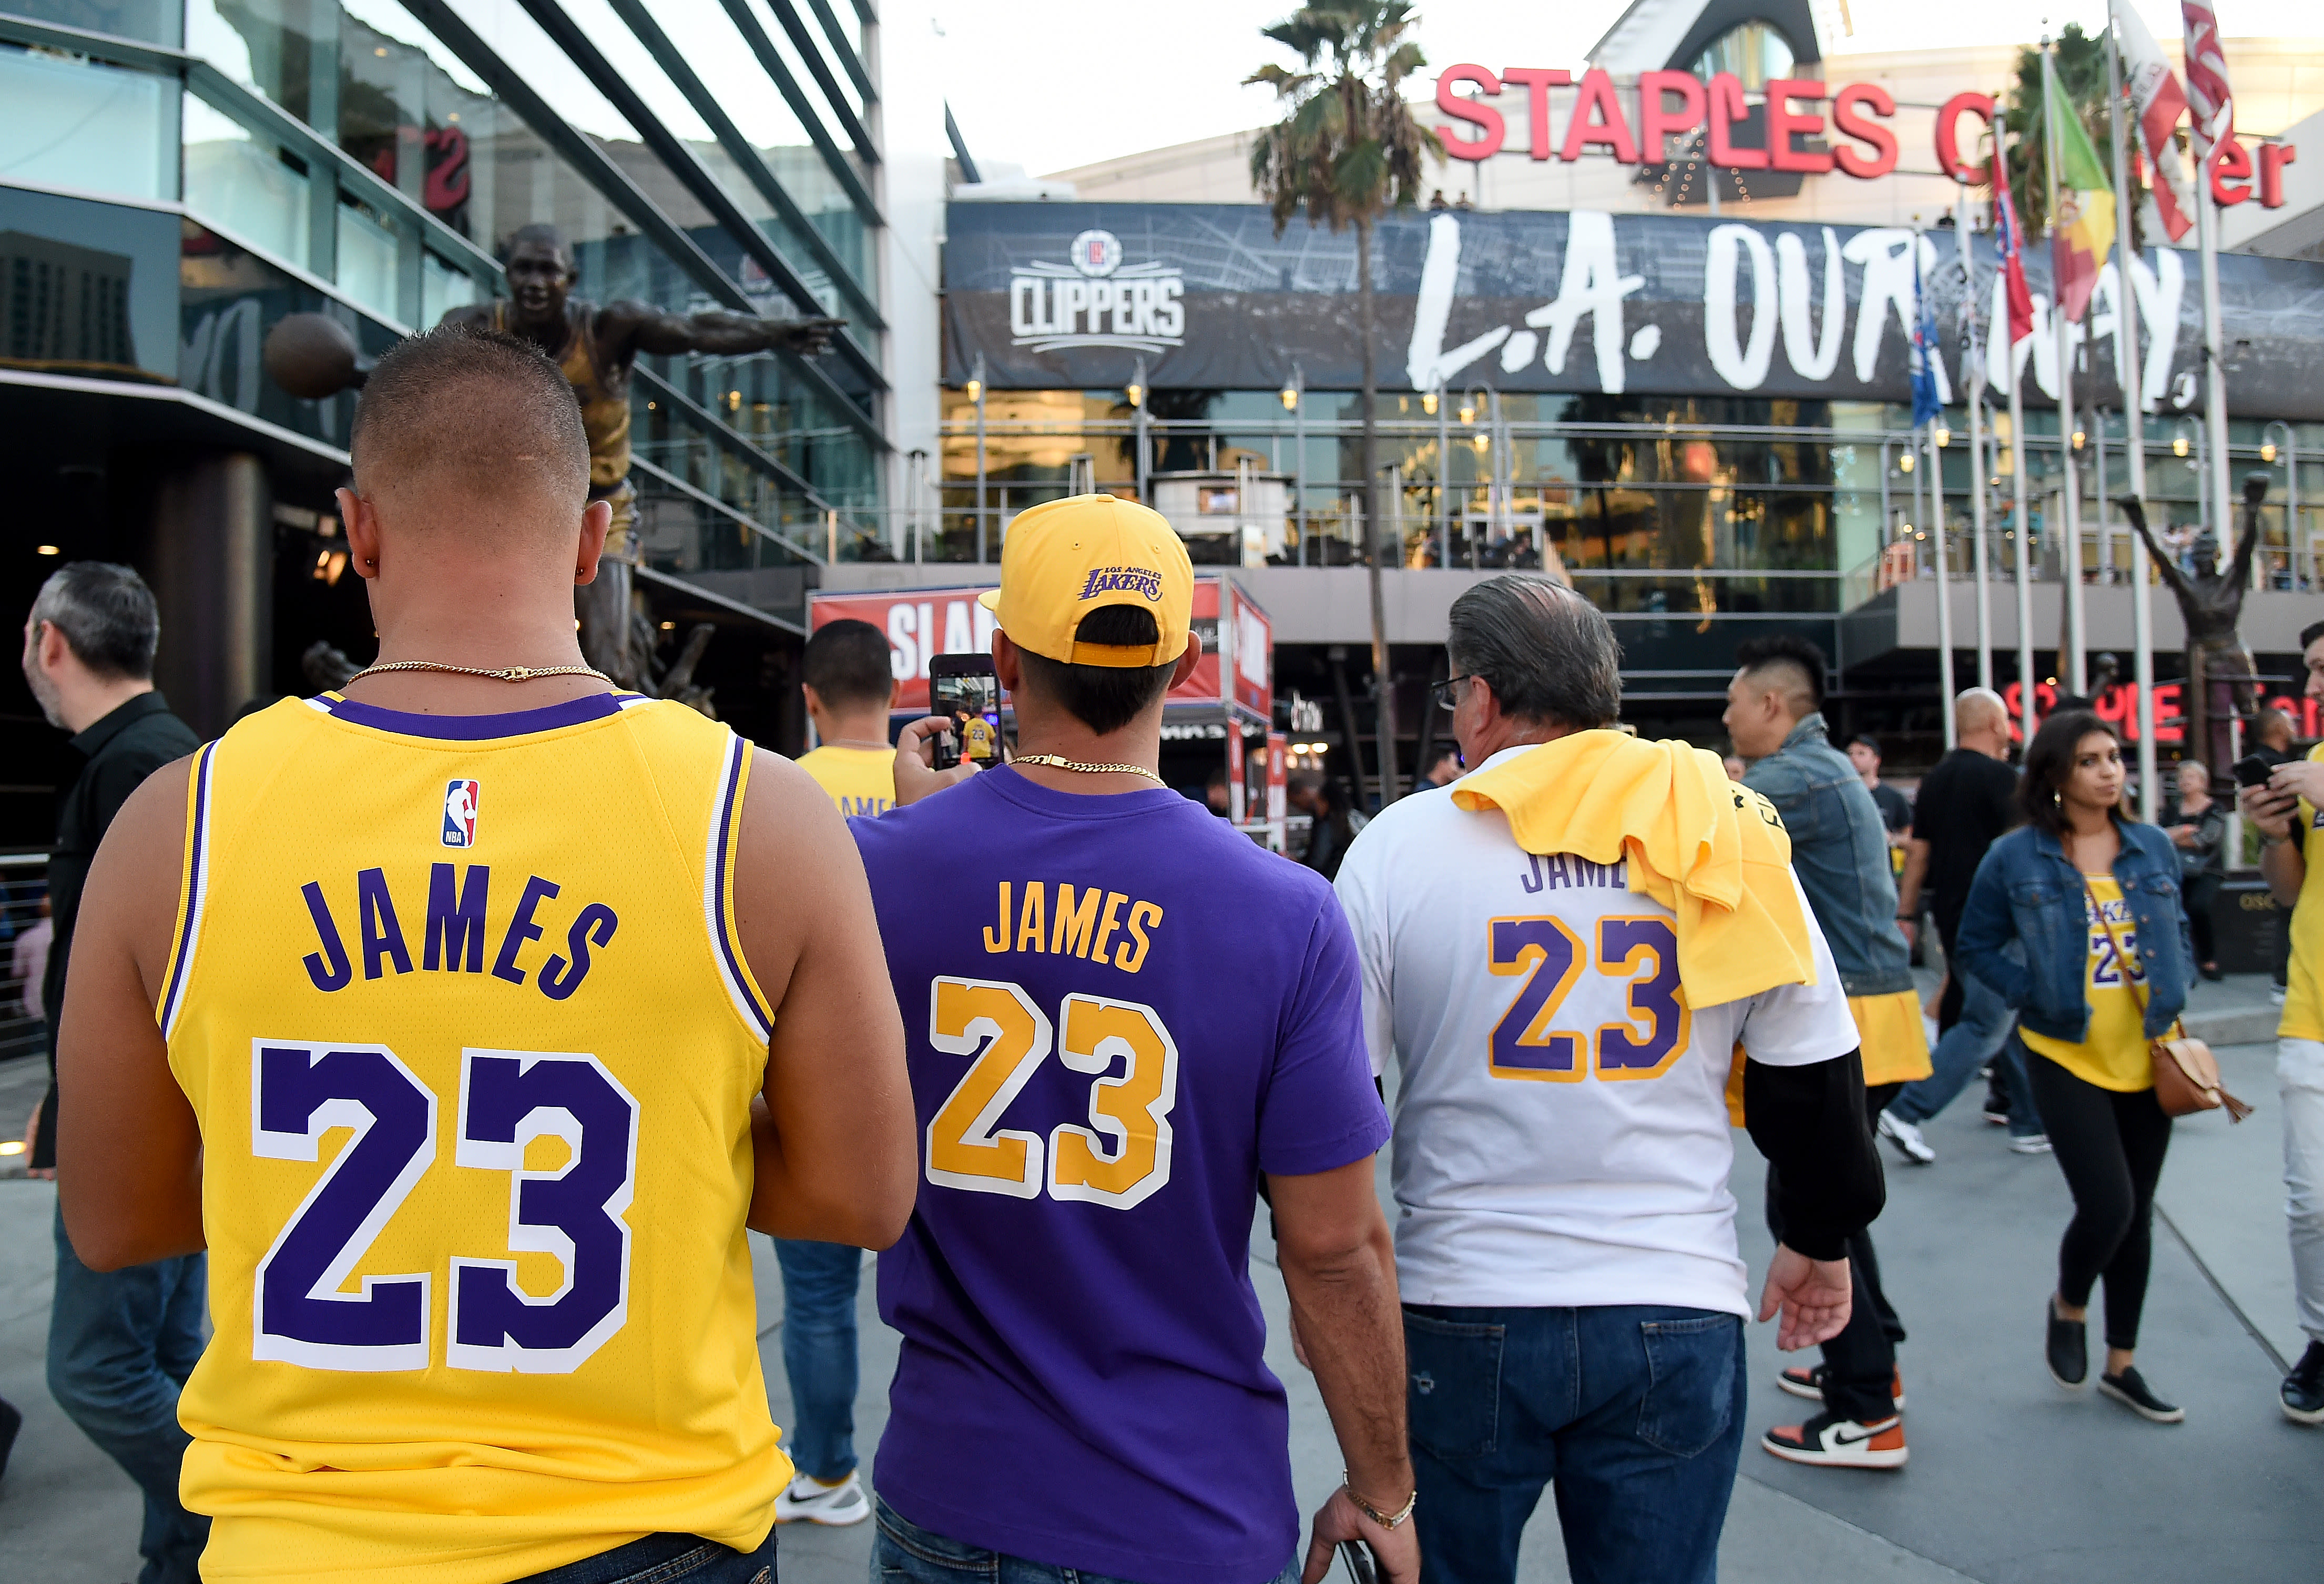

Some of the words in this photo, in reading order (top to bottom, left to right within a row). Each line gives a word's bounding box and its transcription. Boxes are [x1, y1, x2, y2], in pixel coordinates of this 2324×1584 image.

[1435, 63, 1899, 179] STAPLES
[1935, 92, 2296, 209] Cer
[1010, 277, 1185, 337] CLIPPERS
[1406, 211, 1662, 393] L.A.
[1704, 223, 1953, 404] OUR
[1077, 568, 1163, 602] LAKERS
[1125, 566, 1162, 580] ANGELES
[445, 831, 462, 844] NBA
[300, 862, 618, 1001] JAMES
[983, 881, 1164, 973] JAMES
[1487, 915, 1692, 1082] 23
[925, 975, 1179, 1210] 23
[252, 1037, 641, 1374] 23
